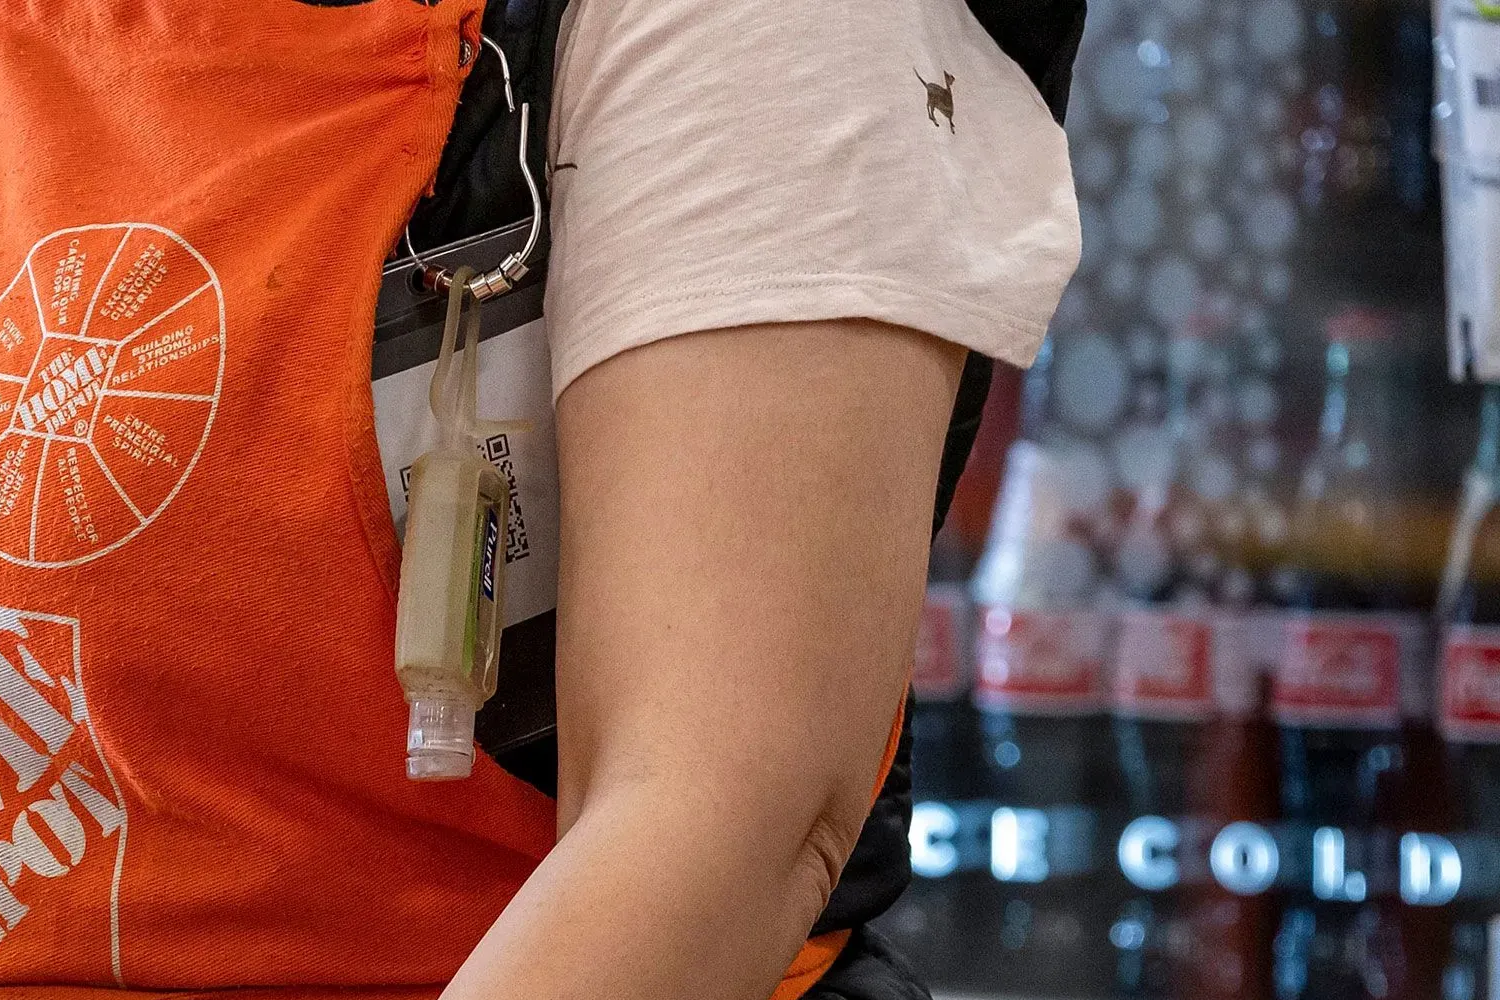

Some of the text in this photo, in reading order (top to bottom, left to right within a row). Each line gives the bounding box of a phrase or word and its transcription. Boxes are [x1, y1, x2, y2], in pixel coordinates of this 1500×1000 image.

[100, 243, 156, 317] EXCELLENT
[111, 250, 165, 320] CUSTOMER
[124, 264, 167, 319] SERVICE
[111, 334, 220, 387] RELATIONSHIPS
[131, 325, 194, 357] BUILDING
[138, 336, 192, 364] STRONG
[19, 341, 114, 432] HOME
[103, 415, 178, 468] PRENEURIAL
[112, 437, 155, 466] SPIRIT
[57, 458, 86, 541] ALL PEOPLE
[67, 447, 99, 545] RESPECT FOR
[907, 802, 1463, 906] CE COLD
